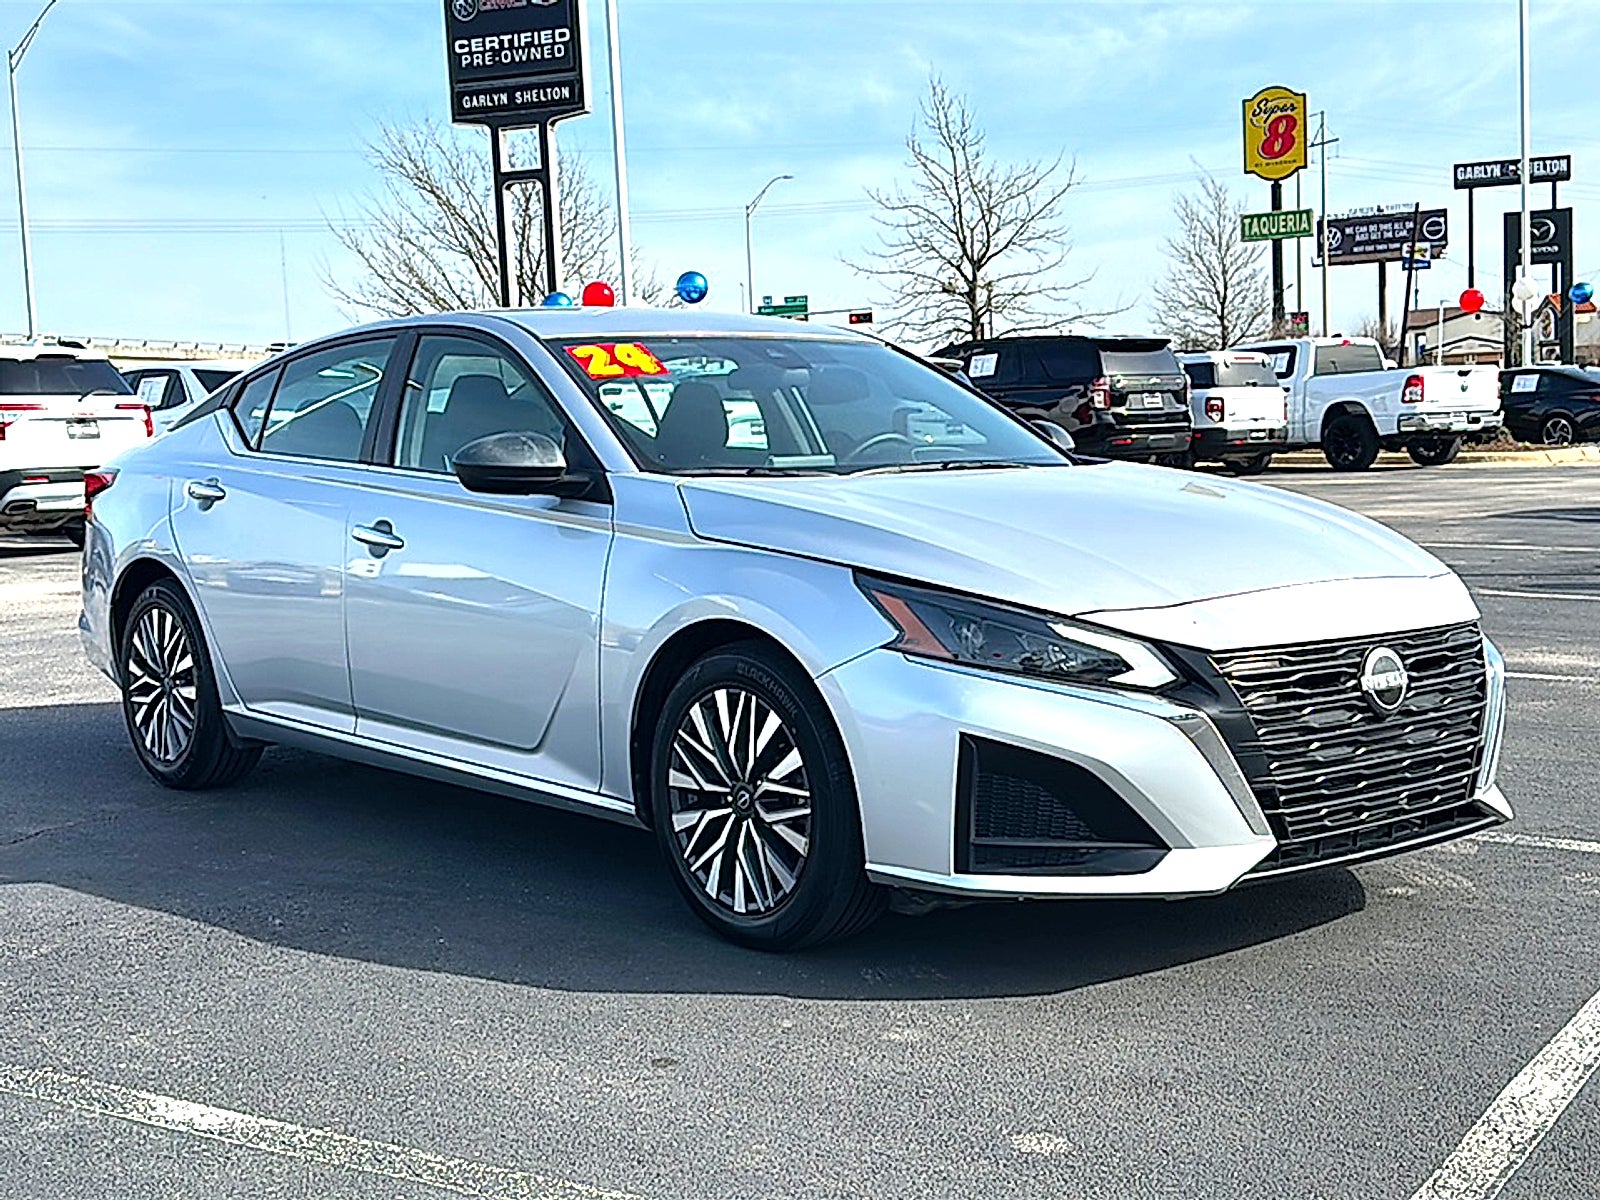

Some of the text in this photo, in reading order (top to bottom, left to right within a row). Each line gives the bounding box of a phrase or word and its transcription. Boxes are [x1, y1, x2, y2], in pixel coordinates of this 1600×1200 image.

[454, 28, 571, 53] CERTIFIED
[461, 44, 565, 68] PRE-OWNED
[462, 86, 570, 109] GARLYN SHELTON
[1251, 97, 1298, 125] Super
[1259, 114, 1298, 159] 8
[1456, 163, 1501, 180] GARLYN
[1243, 212, 1310, 236] TAQUERIA
